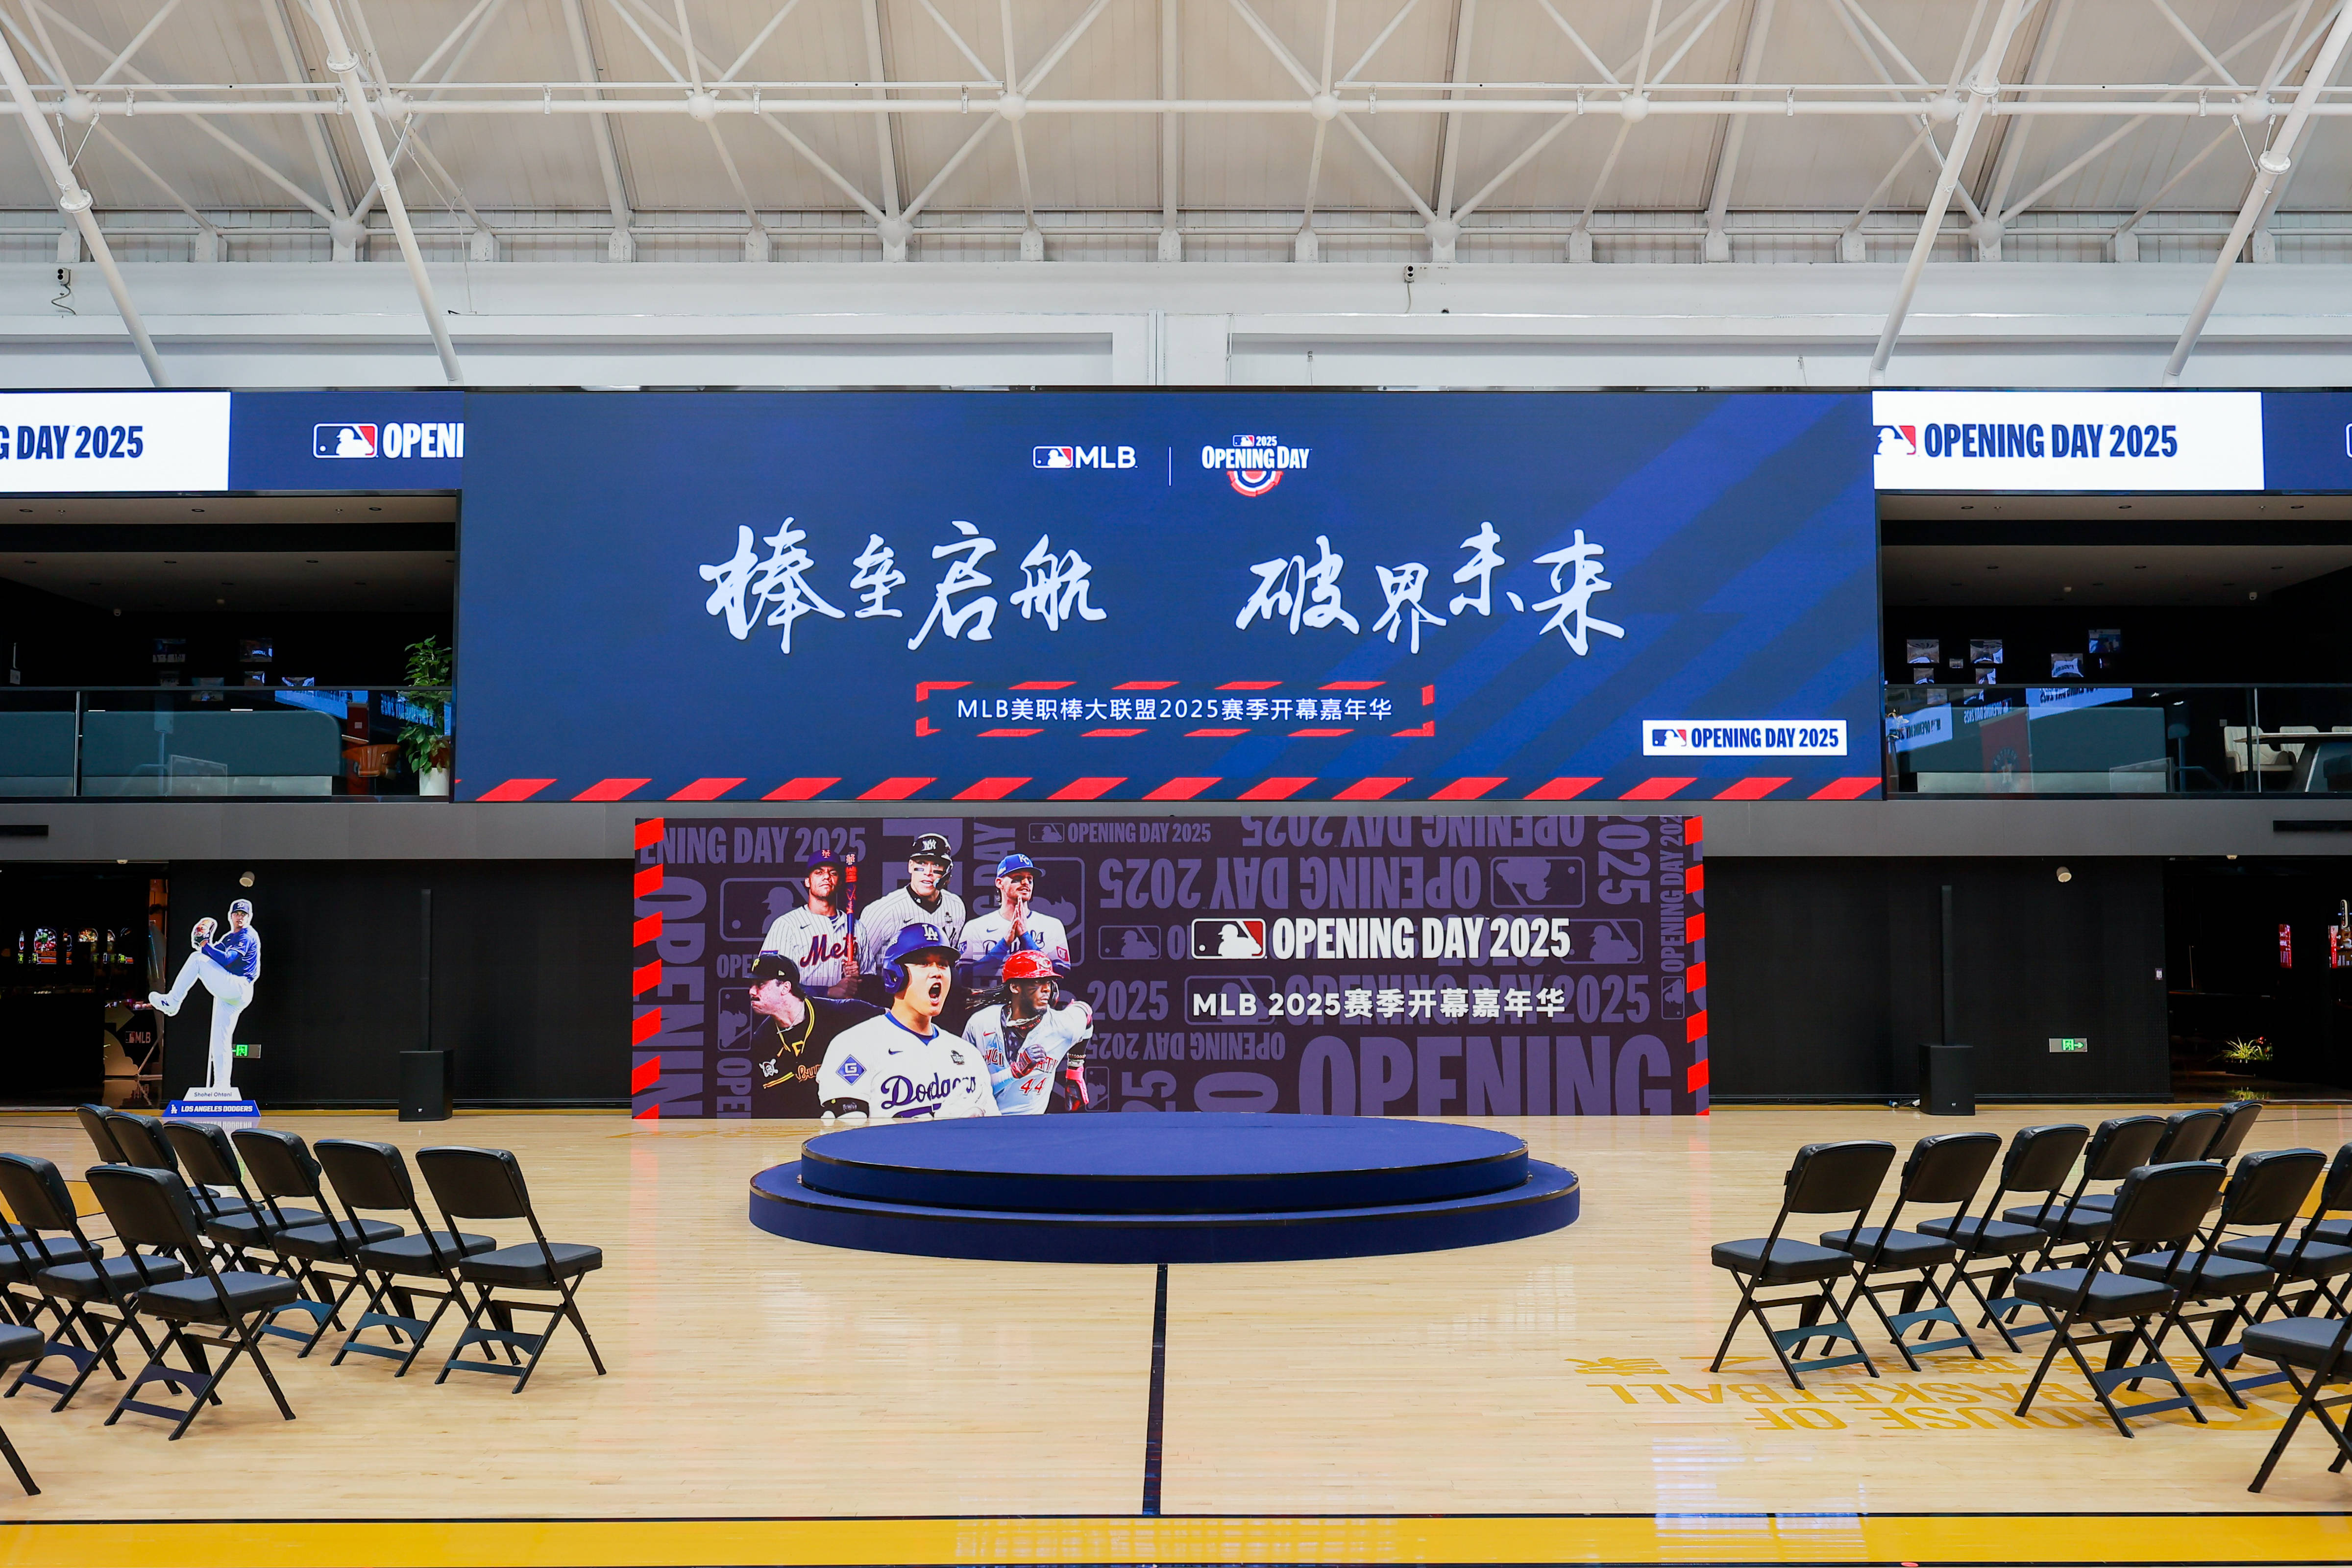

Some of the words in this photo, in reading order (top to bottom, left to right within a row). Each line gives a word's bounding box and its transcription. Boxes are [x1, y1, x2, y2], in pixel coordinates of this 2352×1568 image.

[17, 425, 70, 459] DAY
[75, 425, 143, 458] 2025
[382, 423, 464, 459] OPENI
[1076, 446, 1135, 469] MLB
[1201, 445, 1275, 469] OPENING
[1276, 446, 1310, 469] DAY
[1255, 435, 1277, 446] 2025
[1924, 423, 2044, 458] OPENING
[2052, 424, 2104, 457] DAY
[2110, 425, 2177, 457] 2025
[699, 516, 1106, 654] 棒垒启航
[1236, 521, 1624, 656] 破界未来
[957, 697, 1393, 721] MLB美职棒大联盟2025赛季开幕嘉年华
[1691, 728, 1761, 747] OPENING
[1765, 728, 1796, 747] DAY
[1799, 728, 1838, 747] 2025
[733, 827, 789, 863] DAY
[1068, 822, 1137, 843] OPENING
[1139, 822, 1171, 843] DAY
[1172, 823, 1212, 843] 2025
[1597, 815, 1651, 905] 025
[1660, 850, 1684, 886] DAY
[1099, 858, 1202, 909] 2025
[1205, 857, 1289, 910] DAY
[1299, 856, 1482, 910] OPENING
[1273, 917, 1414, 960] OPENING
[1422, 917, 1485, 959] DAY
[1490, 918, 1571, 958] 2025
[1660, 890, 1685, 973] OPENING
[1086, 980, 1169, 1021] 2025
[1193, 993, 1257, 1016] MLB
[1268, 988, 1566, 1018] 2025赛季开幕嘉年华
[135, 1031, 151, 1044] MLB
[1086, 1032, 1139, 1060] 2025
[1143, 1032, 1185, 1060] DAY
[1190, 1032, 1286, 1060] OPENING
[716, 1057, 753, 1118] OPE
[880, 1072, 976, 1110] Dodgs
[1019, 1078, 1047, 1095] 44
[1298, 1034, 1672, 1117] OPENING
[1586, 1383, 2093, 1404] BASKETBALL
[1744, 1407, 1849, 1431] OF
